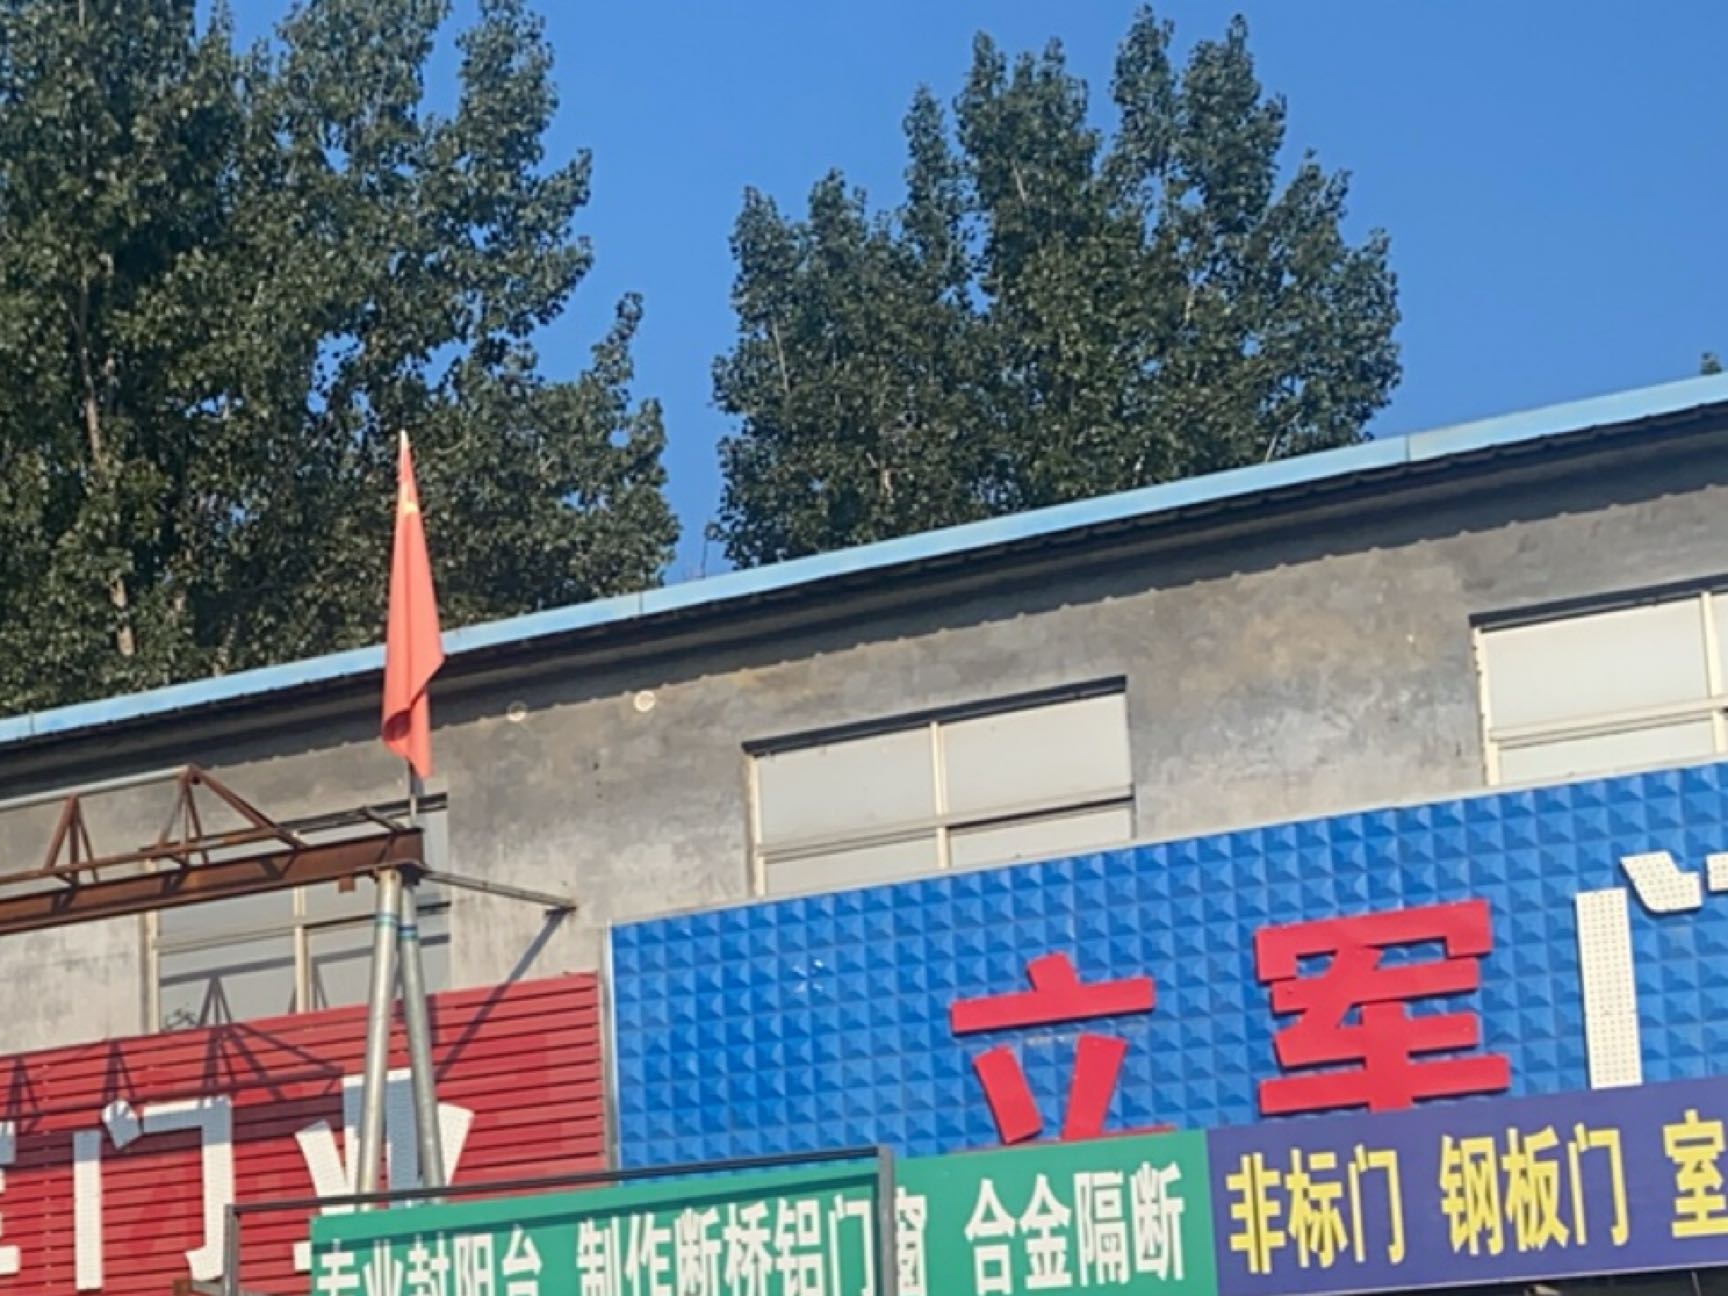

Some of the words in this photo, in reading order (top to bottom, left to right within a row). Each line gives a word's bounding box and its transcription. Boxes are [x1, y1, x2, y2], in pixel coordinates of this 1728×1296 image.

[964, 1161, 1185, 1296] 合金隔断
[1226, 1144, 1406, 1275] 非标门
[1439, 1122, 1629, 1256] 钢板门
